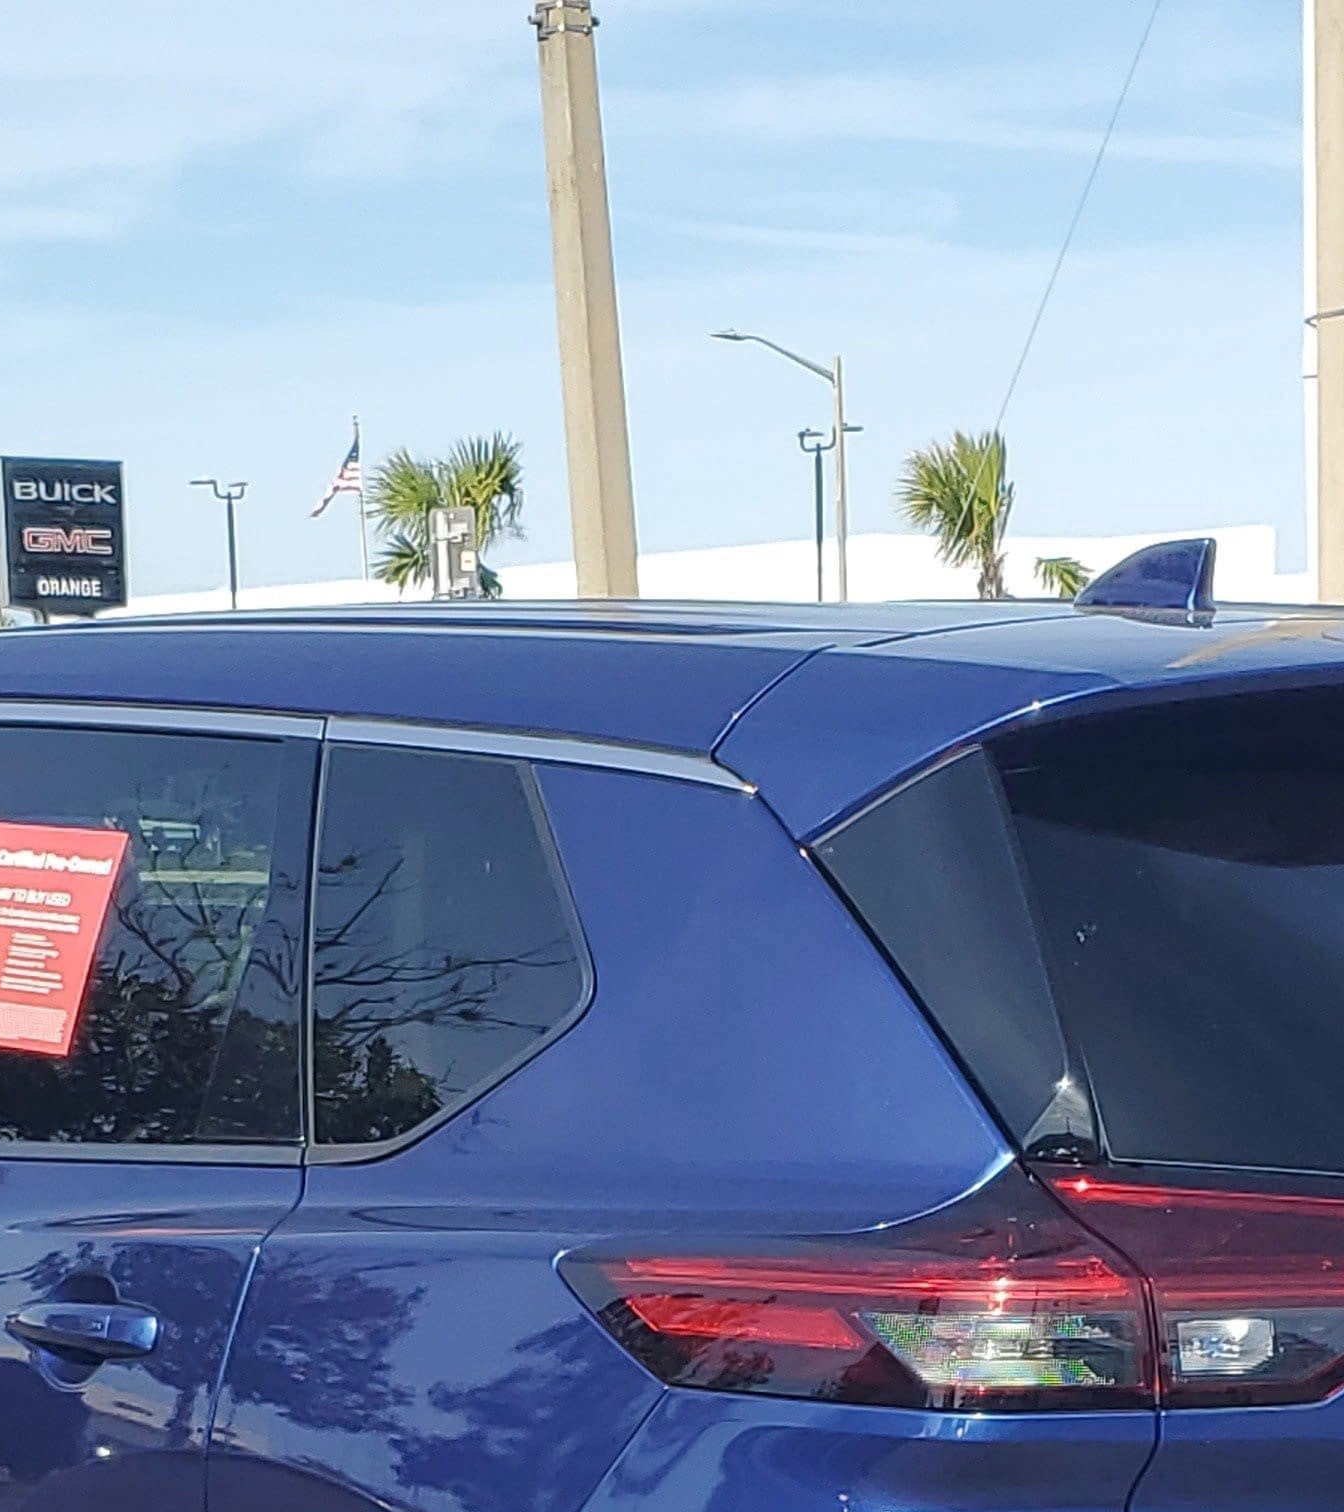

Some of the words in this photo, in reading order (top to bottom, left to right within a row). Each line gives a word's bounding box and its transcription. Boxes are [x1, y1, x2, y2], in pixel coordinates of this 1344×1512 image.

[12, 479, 117, 504] BUICK
[23, 526, 113, 555] GMC
[37, 576, 102, 597] ORANGE
